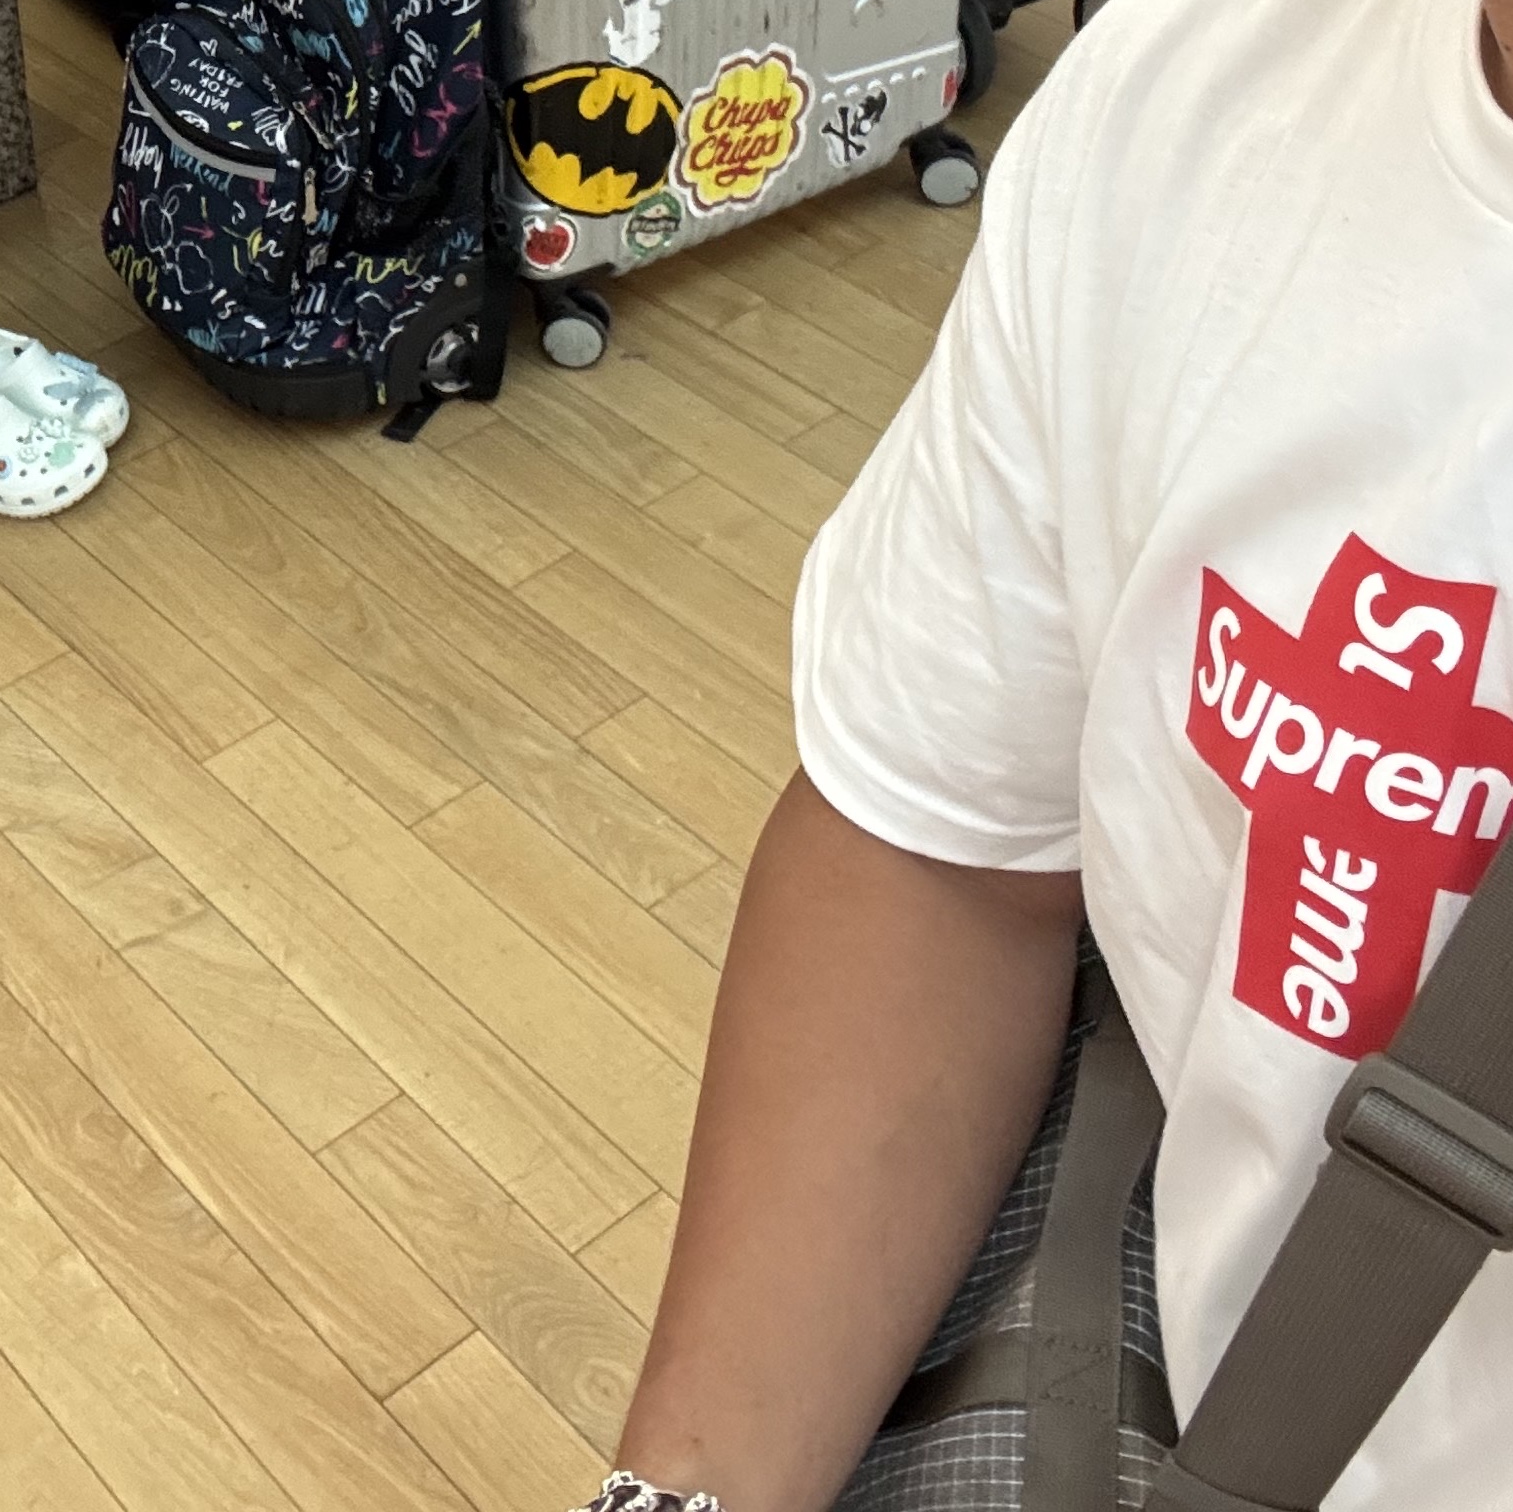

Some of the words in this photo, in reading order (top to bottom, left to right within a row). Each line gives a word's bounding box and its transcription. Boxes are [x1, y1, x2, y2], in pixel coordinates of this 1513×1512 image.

[169, 78, 231, 115] WAITING
[702, 93, 793, 135] Chupa
[689, 130, 784, 188] Chups
